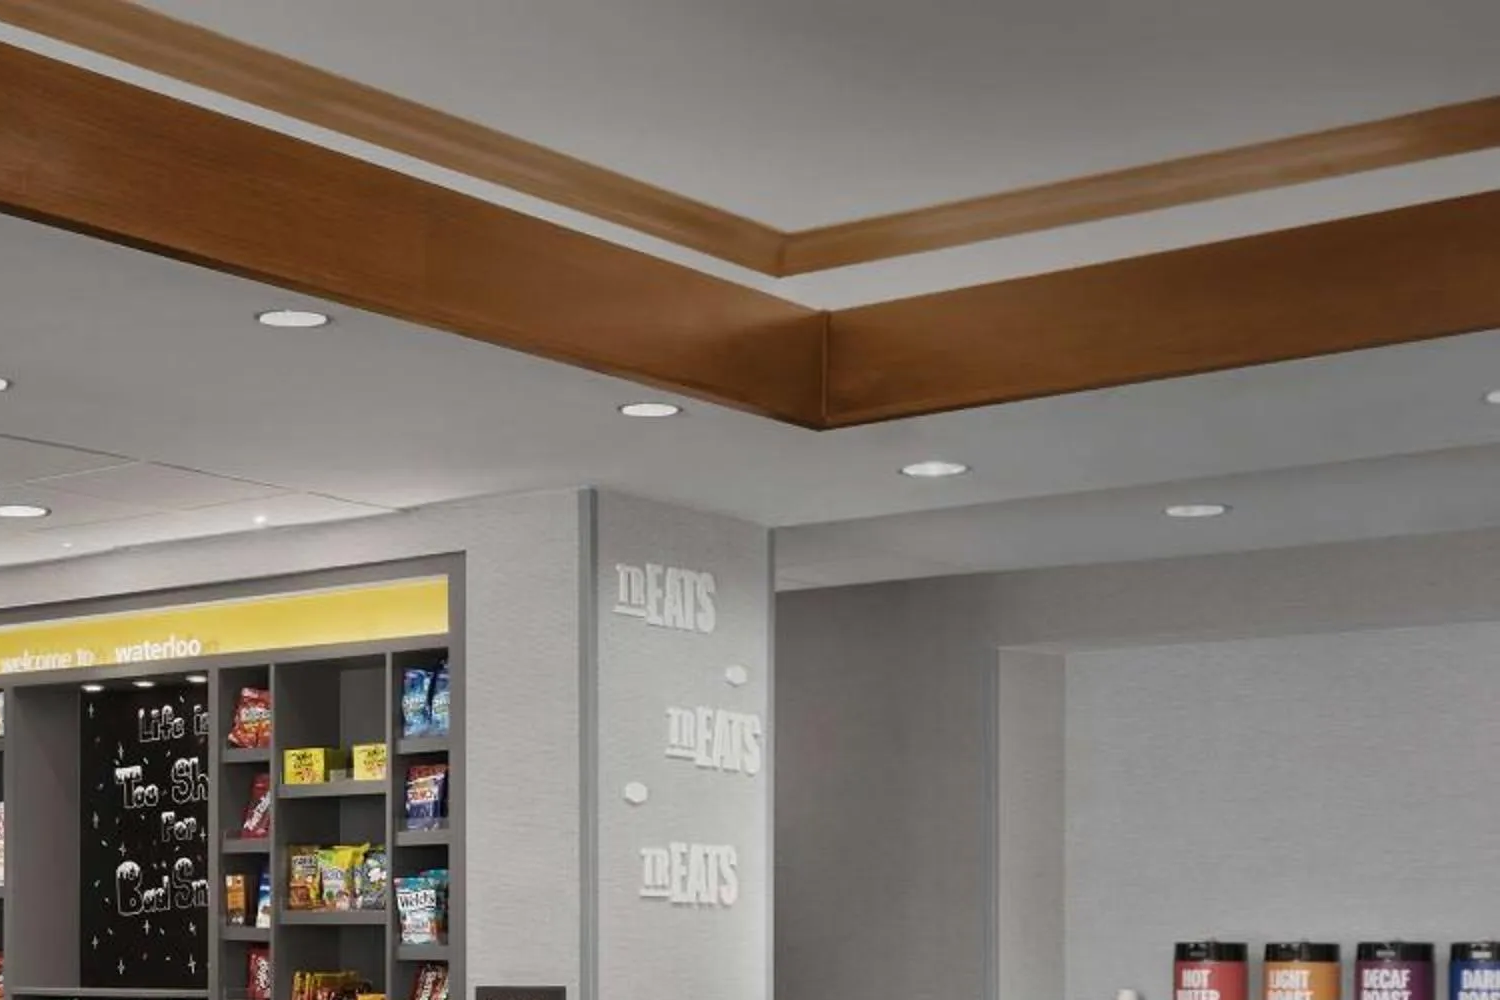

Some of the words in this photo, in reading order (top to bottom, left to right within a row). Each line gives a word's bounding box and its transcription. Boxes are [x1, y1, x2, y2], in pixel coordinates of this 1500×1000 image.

[0, 649, 72, 673] welcome
[76, 648, 96, 667] to
[115, 634, 201, 664] waterloo
[138, 705, 185, 742] Life
[115, 765, 159, 809] Too
[161, 811, 197, 842] For
[116, 861, 171, 916] Bad
[1182, 969, 1212, 988] HOT
[1268, 969, 1310, 989] LIGHT
[1362, 969, 1411, 989] DECAF
